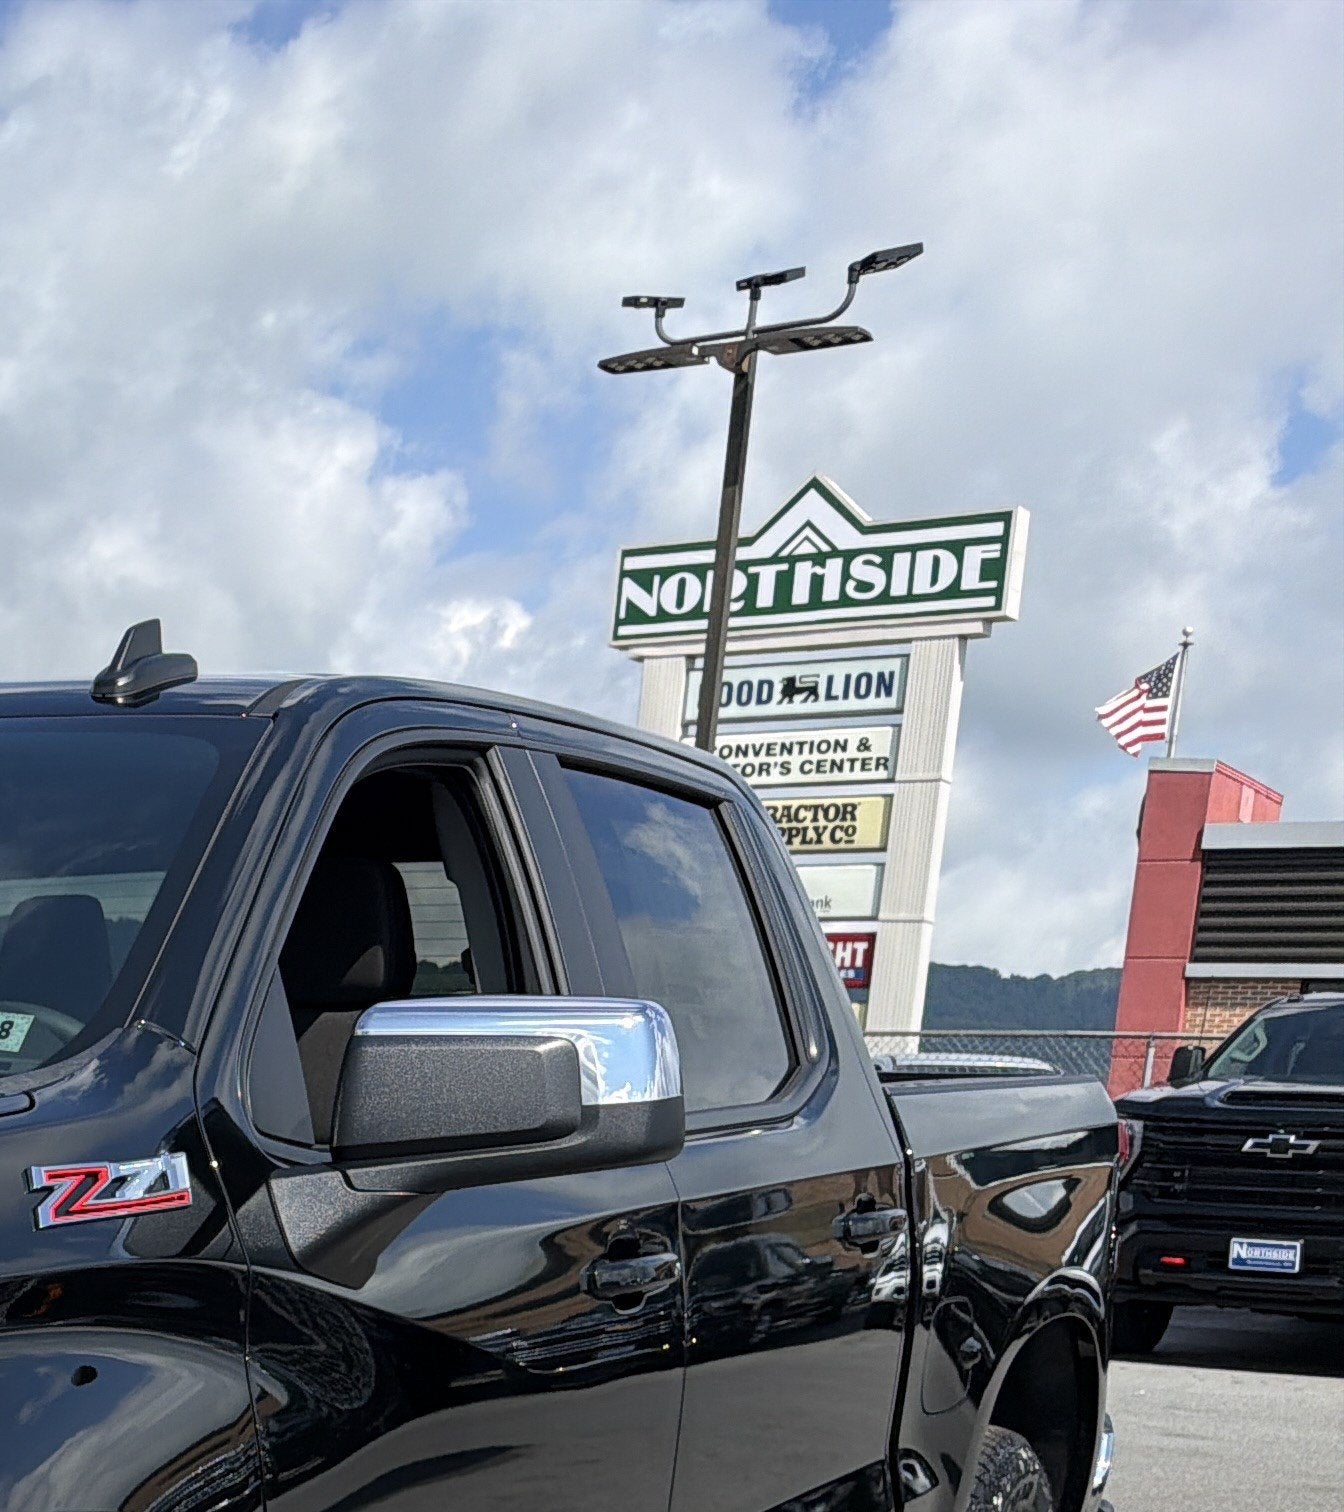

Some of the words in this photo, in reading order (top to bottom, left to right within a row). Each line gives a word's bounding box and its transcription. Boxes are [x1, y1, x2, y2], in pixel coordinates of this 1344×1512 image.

[618, 543, 1003, 620] NORTHSIDE
[719, 679, 775, 708] OOD
[824, 670, 896, 702] LION
[715, 738, 849, 760] ONVENTION
[855, 736, 873, 753] &
[799, 756, 890, 774] CENTER
[765, 802, 858, 824] RACTOR
[29, 1150, 193, 1231] Z71
